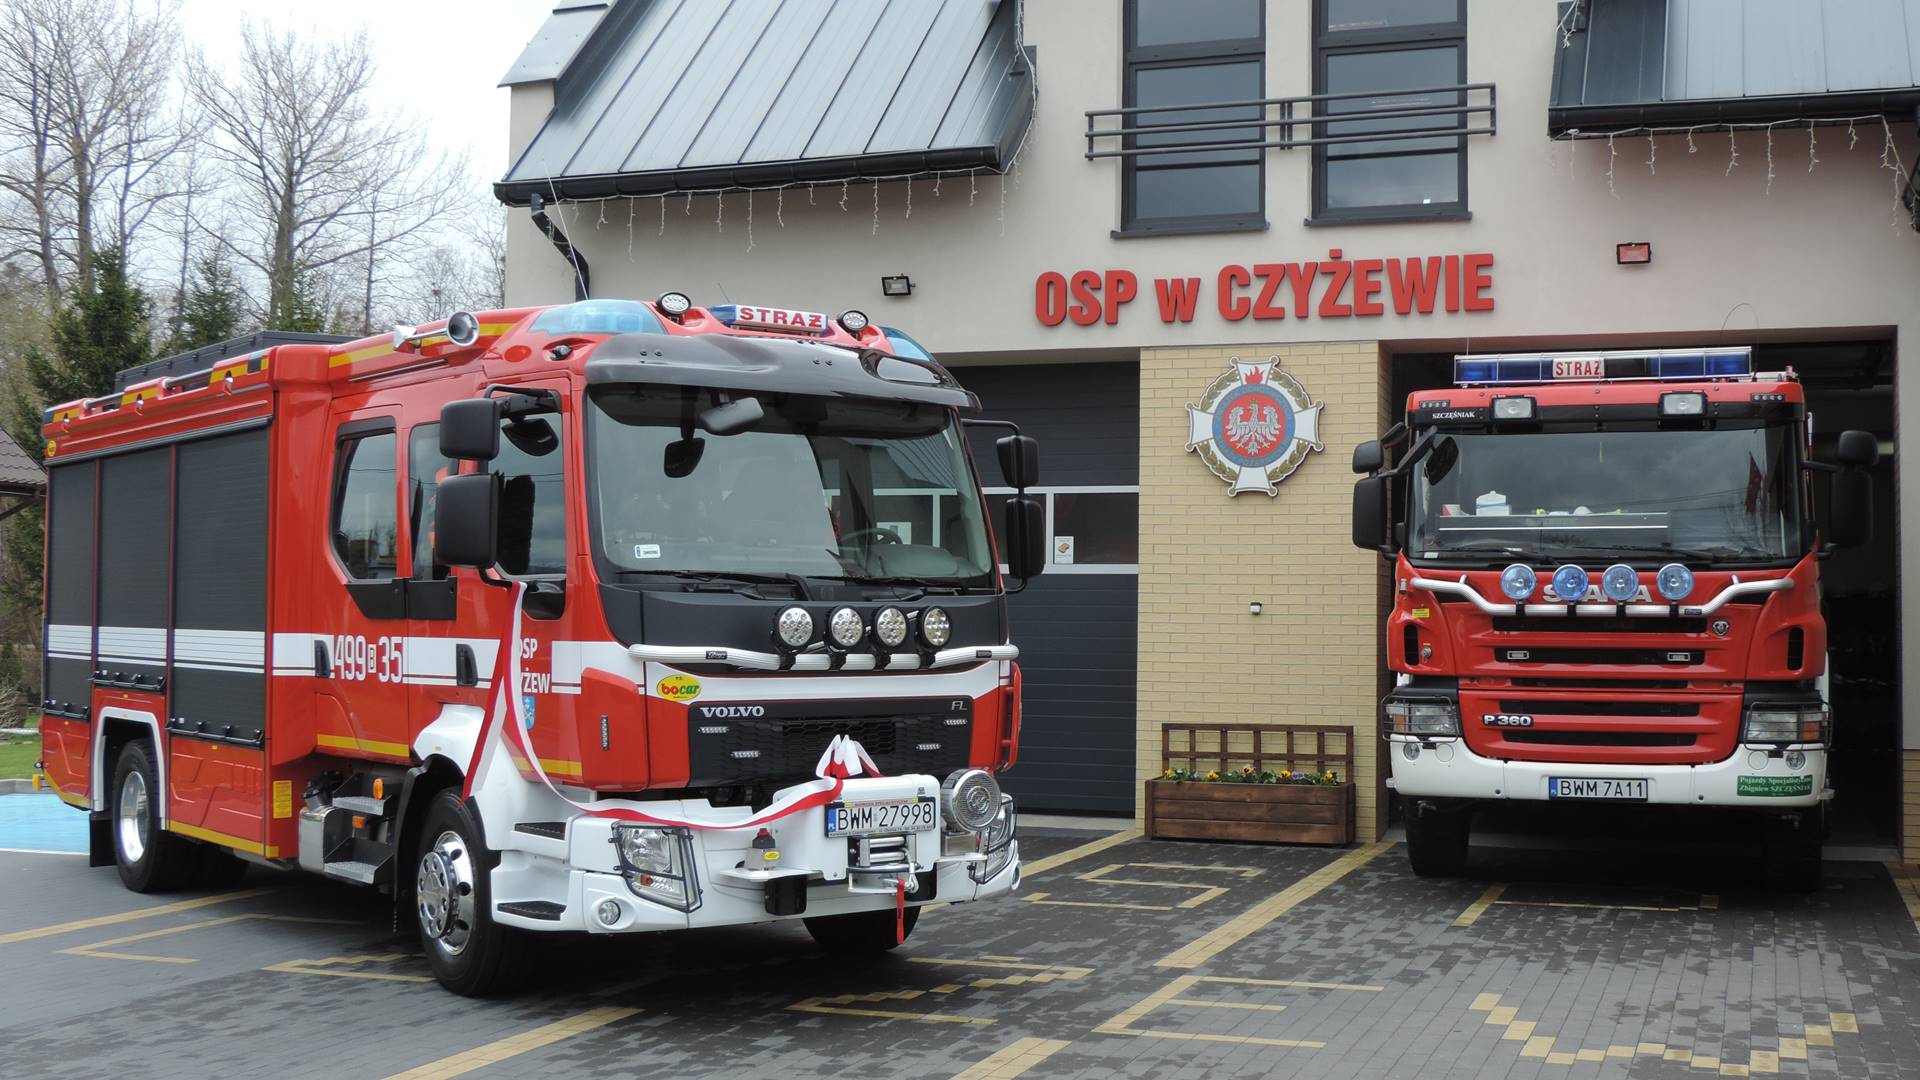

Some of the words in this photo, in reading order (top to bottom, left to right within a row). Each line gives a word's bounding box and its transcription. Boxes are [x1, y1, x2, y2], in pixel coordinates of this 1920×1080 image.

[1035, 270, 1138, 326] OSP
[1217, 249, 1495, 321] CZYŻEWIE
[661, 684, 699, 695] bocar
[951, 700, 968, 711] FL
[700, 706, 765, 718] VOLVO
[1484, 715, 1495, 725] P
[1497, 715, 1531, 726] 360
[1560, 780, 1598, 796] BWM
[1603, 781, 1643, 797] 7A11
[838, 807, 873, 831] BWM
[879, 803, 932, 827] 27998
